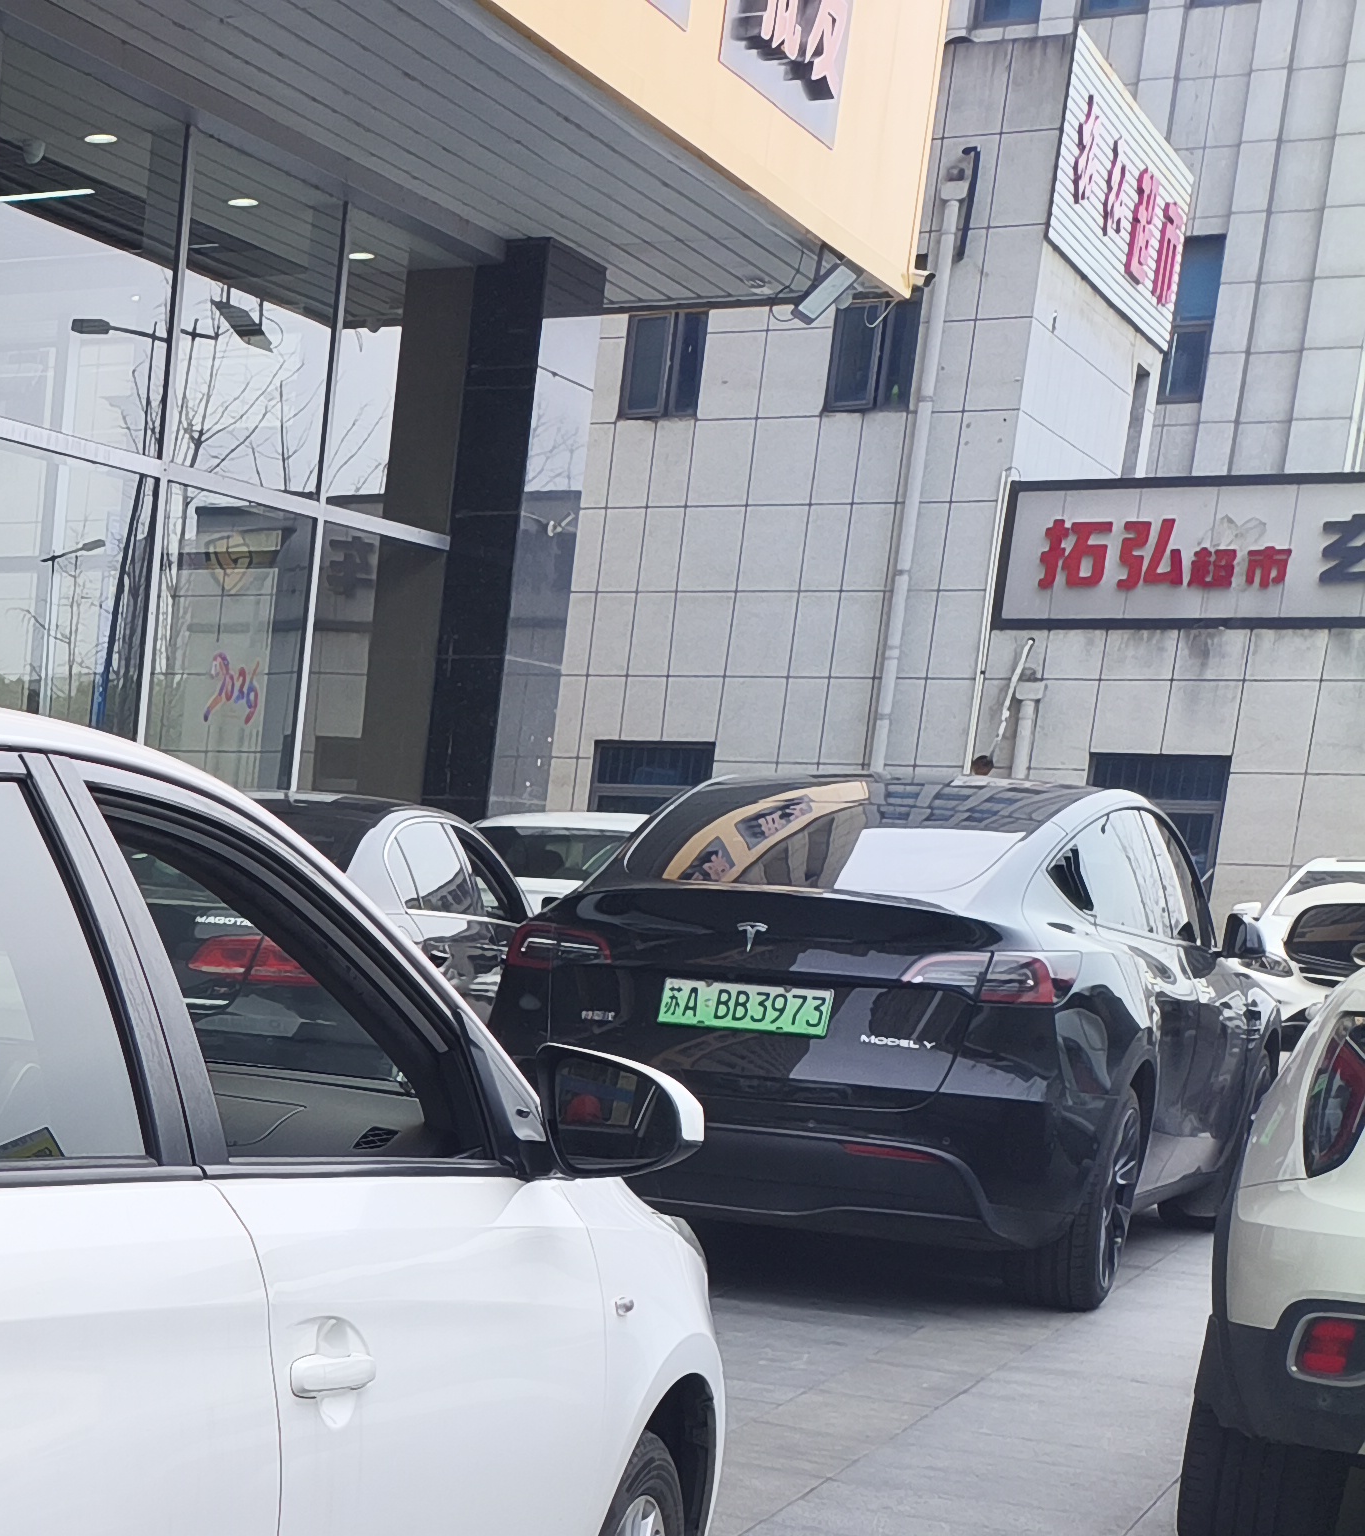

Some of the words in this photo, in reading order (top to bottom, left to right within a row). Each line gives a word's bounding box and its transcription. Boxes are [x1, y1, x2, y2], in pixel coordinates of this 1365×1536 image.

[1037, 517, 1293, 590] 拓弘超市
[860, 1034, 920, 1048] MODEL
[923, 1040, 936, 1049] Y
